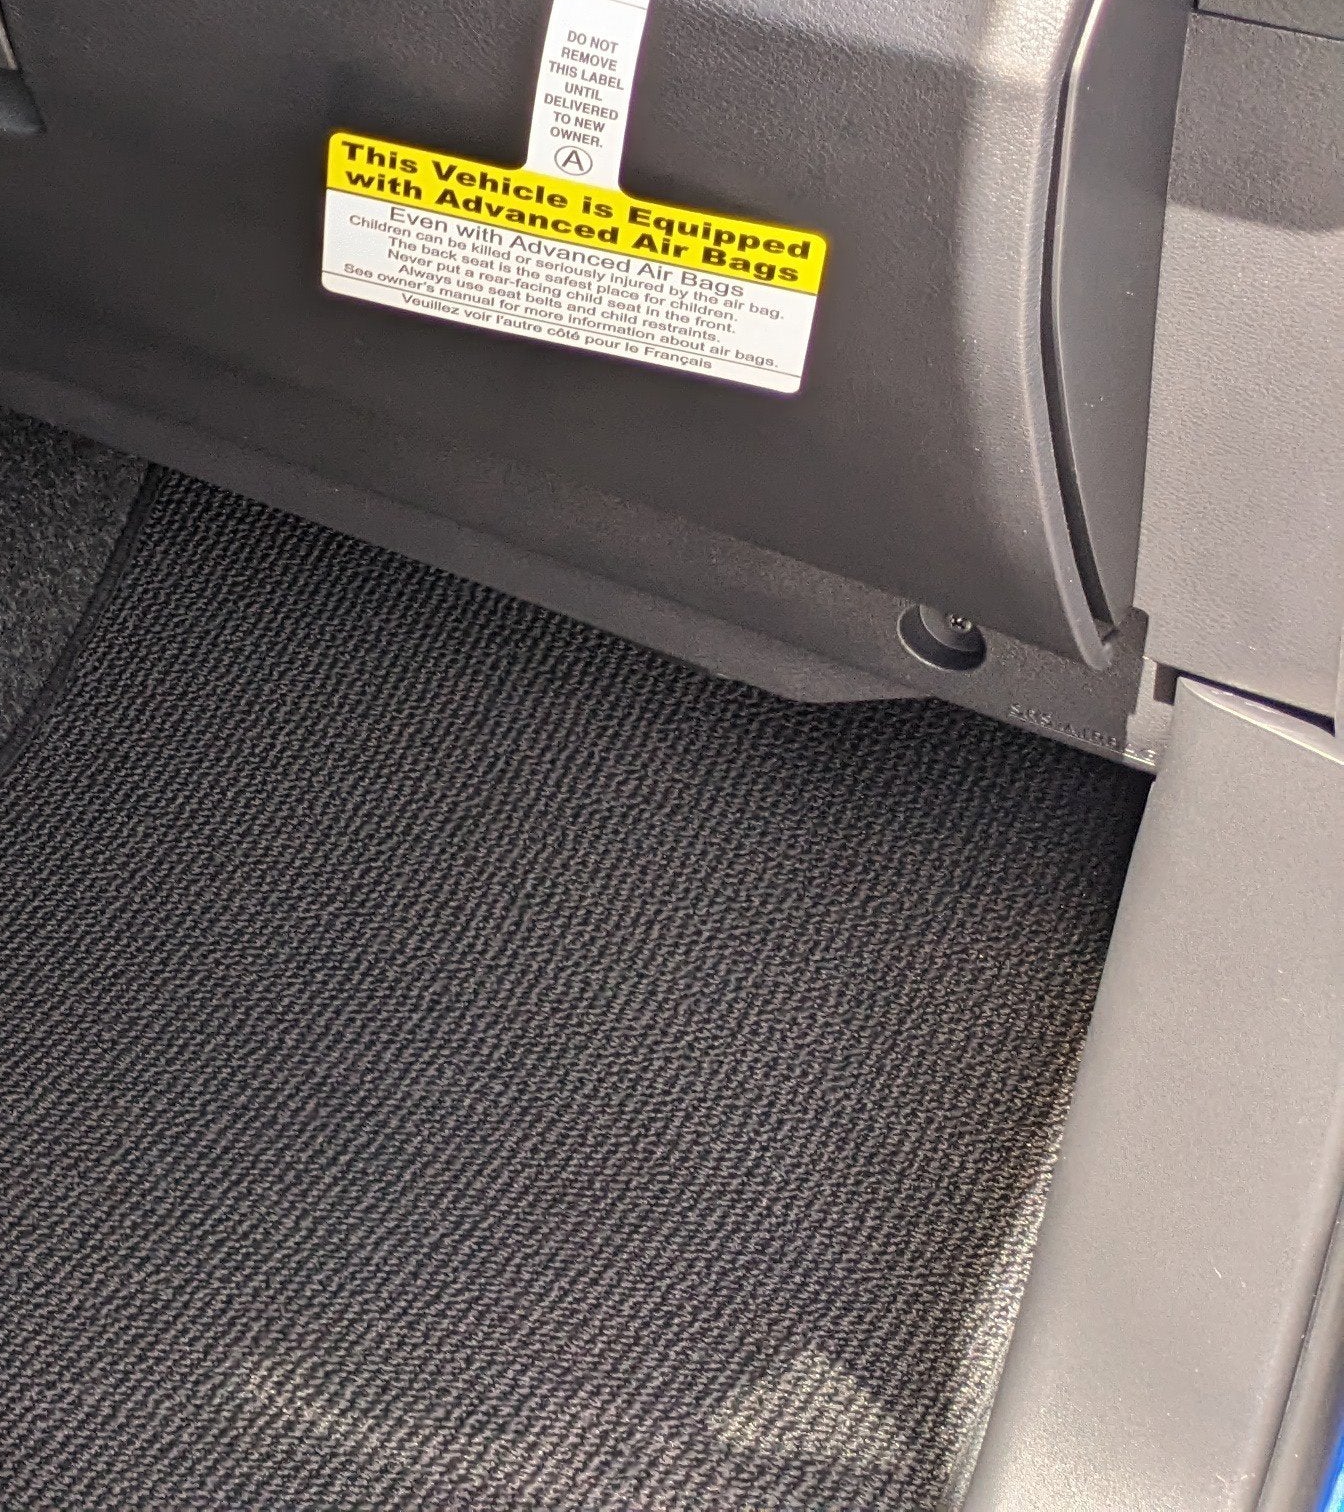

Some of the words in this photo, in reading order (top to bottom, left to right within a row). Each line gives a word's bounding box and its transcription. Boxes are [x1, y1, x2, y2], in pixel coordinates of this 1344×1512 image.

[548, 59, 578, 79] THIS
[580, 69, 625, 91] LABEL
[561, 46, 618, 72] REMOVE
[567, 29, 587, 46] DO
[589, 36, 619, 54] NOT
[543, 93, 619, 121] DELIVERED
[553, 111, 571, 125] TO
[574, 116, 606, 133] NEW
[564, 81, 603, 102] UNTIL
[549, 126, 603, 148] OWNER.
[341, 140, 418, 175] This
[431, 161, 569, 209] Vehicle
[581, 195, 614, 219] is
[627, 205, 811, 260] Equipped
[345, 170, 423, 201] with
[434, 187, 620, 245] Advanced
[630, 232, 690, 259] Air
[701, 245, 799, 282] Bags
[349, 214, 412, 238] Children
[415, 231, 443, 245] can
[447, 236, 467, 251] be
[471, 242, 511, 261] killed
[515, 255, 532, 265] or
[535, 259, 606, 282] seriously
[610, 272, 665, 294] injured
[668, 285, 689, 300] by
[693, 290, 719, 305] the
[722, 299, 745, 310] air
[749, 302, 784, 320] bag.
[387, 248, 433, 268] Never
[436, 262, 461, 275] put
[464, 269, 475, 279] a
[478, 272, 562, 299] rear-facing
[566, 290, 603, 306] child
[607, 299, 642, 314] seat
[645, 305, 660, 318] in
[664, 309, 690, 324] the
[695, 316, 735, 334] front.
[388, 235, 417, 252] The
[421, 243, 457, 262] back
[461, 255, 495, 271] seat
[498, 261, 512, 274] is
[516, 265, 541, 280] the
[544, 274, 593, 291] safest
[596, 284, 640, 301] place
[643, 292, 667, 306] for
[669, 299, 738, 322] children.
[389, 206, 448, 234] Even
[455, 224, 503, 246] with
[508, 234, 631, 274] Advanced
[636, 262, 674, 282] Air
[680, 270, 744, 298] Bags
[343, 263, 373, 279] See
[376, 273, 435, 293] owner's
[439, 287, 495, 307] manual
[499, 299, 521, 312] for
[524, 306, 564, 322] more
[568, 313, 655, 341] information
[659, 334, 706, 352] about
[709, 345, 731, 357] air
[734, 349, 778, 368] bags.
[397, 264, 452, 285] Always
[456, 279, 484, 292] use
[488, 286, 521, 301] seat
[525, 292, 563, 309] belts
[566, 303, 597, 317] and
[600, 310, 638, 325] child
[642, 319, 720, 343] restraints.
[401, 292, 460, 316] Veuillez
[464, 309, 493, 322] voir
[495, 314, 543, 333] l'autre
[546, 327, 581, 341] côté
[584, 335, 621, 350] pour
[624, 341, 639, 354] le
[644, 346, 712, 369] Français
